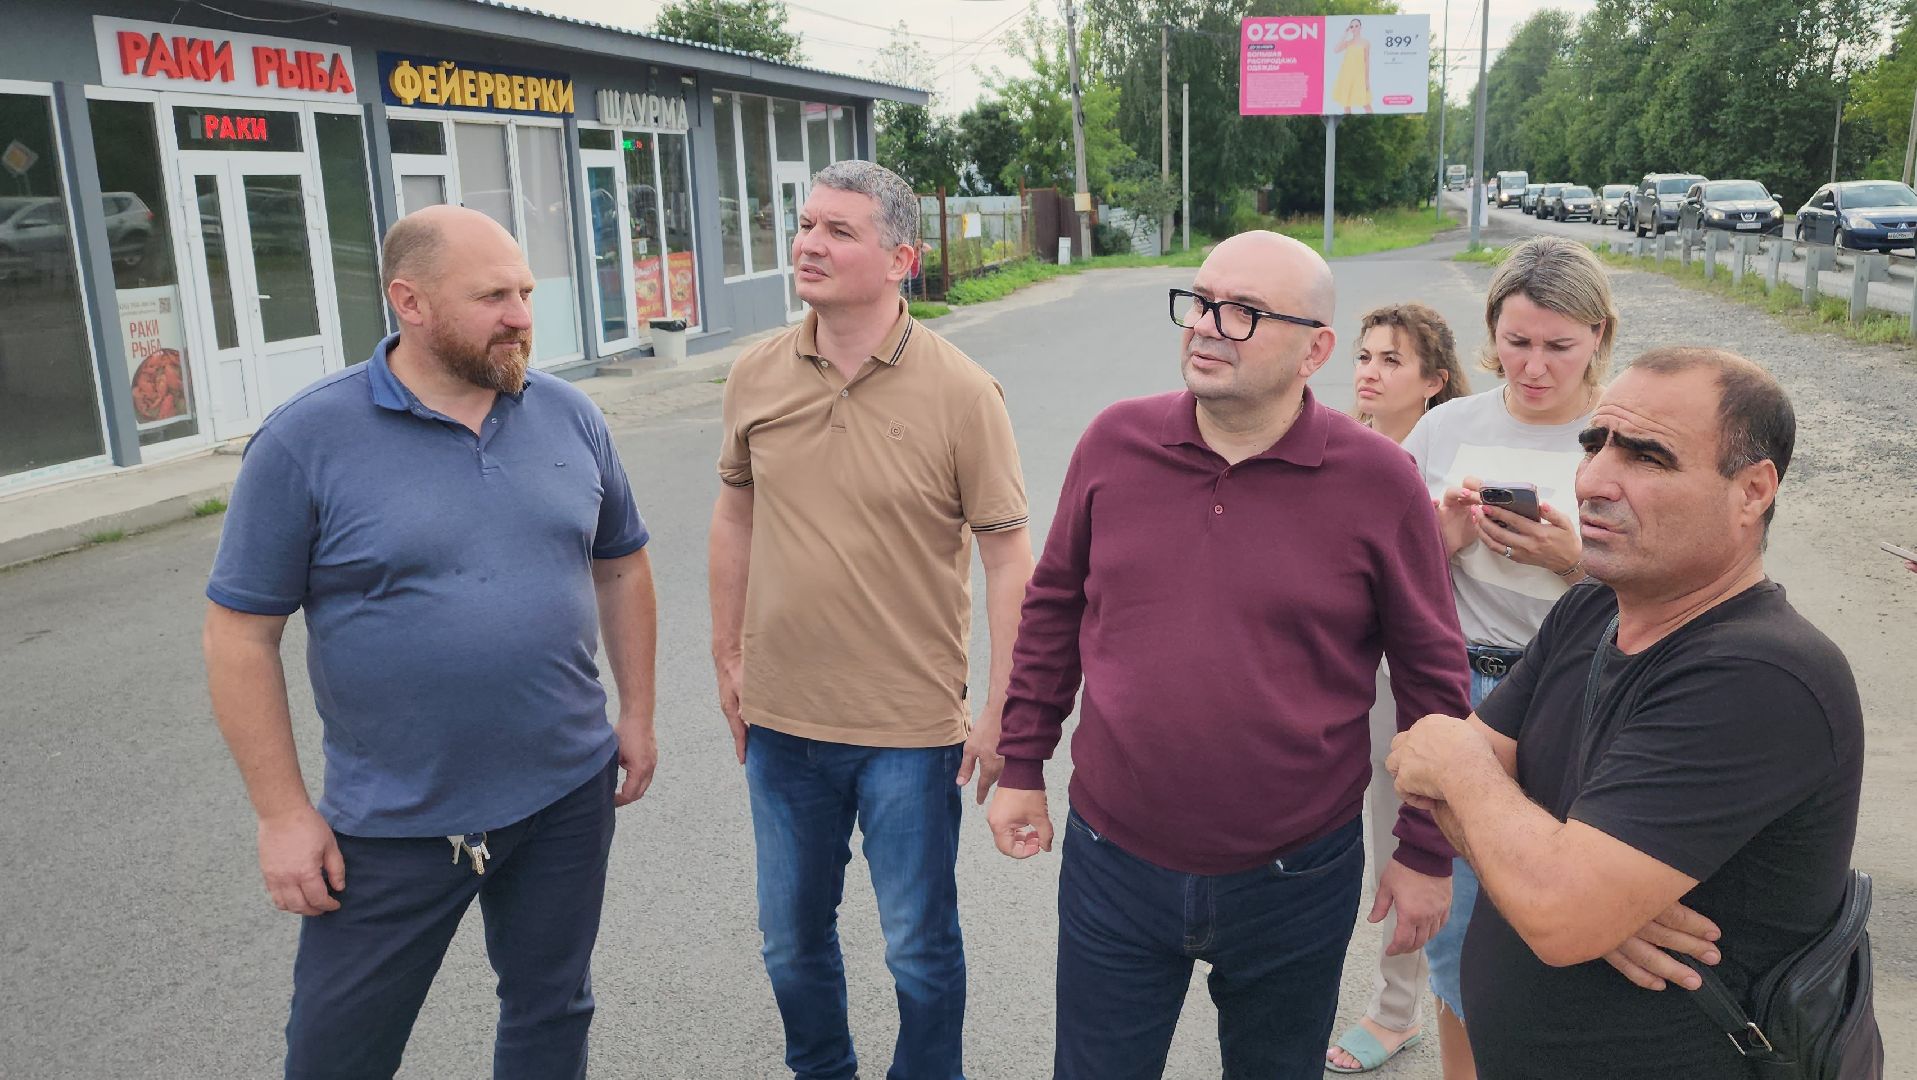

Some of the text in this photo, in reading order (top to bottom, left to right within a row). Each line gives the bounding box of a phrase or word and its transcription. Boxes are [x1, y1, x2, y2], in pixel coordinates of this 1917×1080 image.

[1247, 23, 1318, 41] OZON
[1385, 36, 1412, 48] 899
[116, 31, 354, 93] РАКИ РЫБА
[390, 60, 575, 114] ФЕЙЕРВЕРКИ
[597, 88, 690, 131] ШАУРМА
[204, 114, 268, 142] РАКИ
[129, 319, 160, 339] РАКИ
